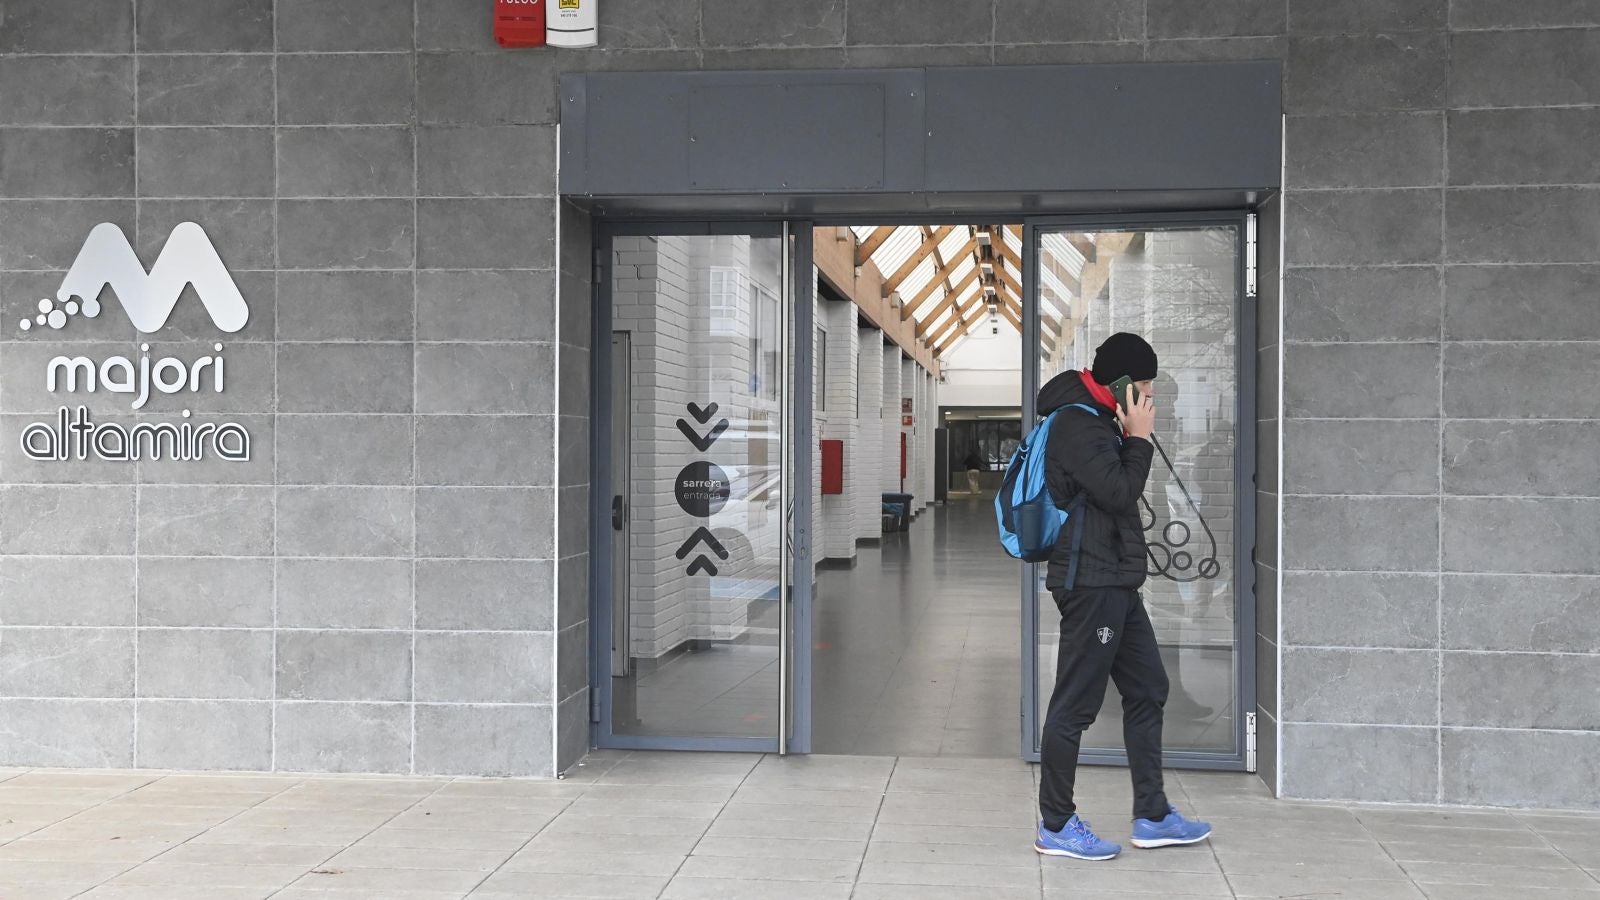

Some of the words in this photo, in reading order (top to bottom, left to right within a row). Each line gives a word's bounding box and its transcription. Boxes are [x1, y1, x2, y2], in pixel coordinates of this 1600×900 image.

[47, 342, 224, 409] majori
[20, 405, 250, 461] altamira
[683, 480, 721, 488] sarrera
[683, 490, 721, 500] entrada
